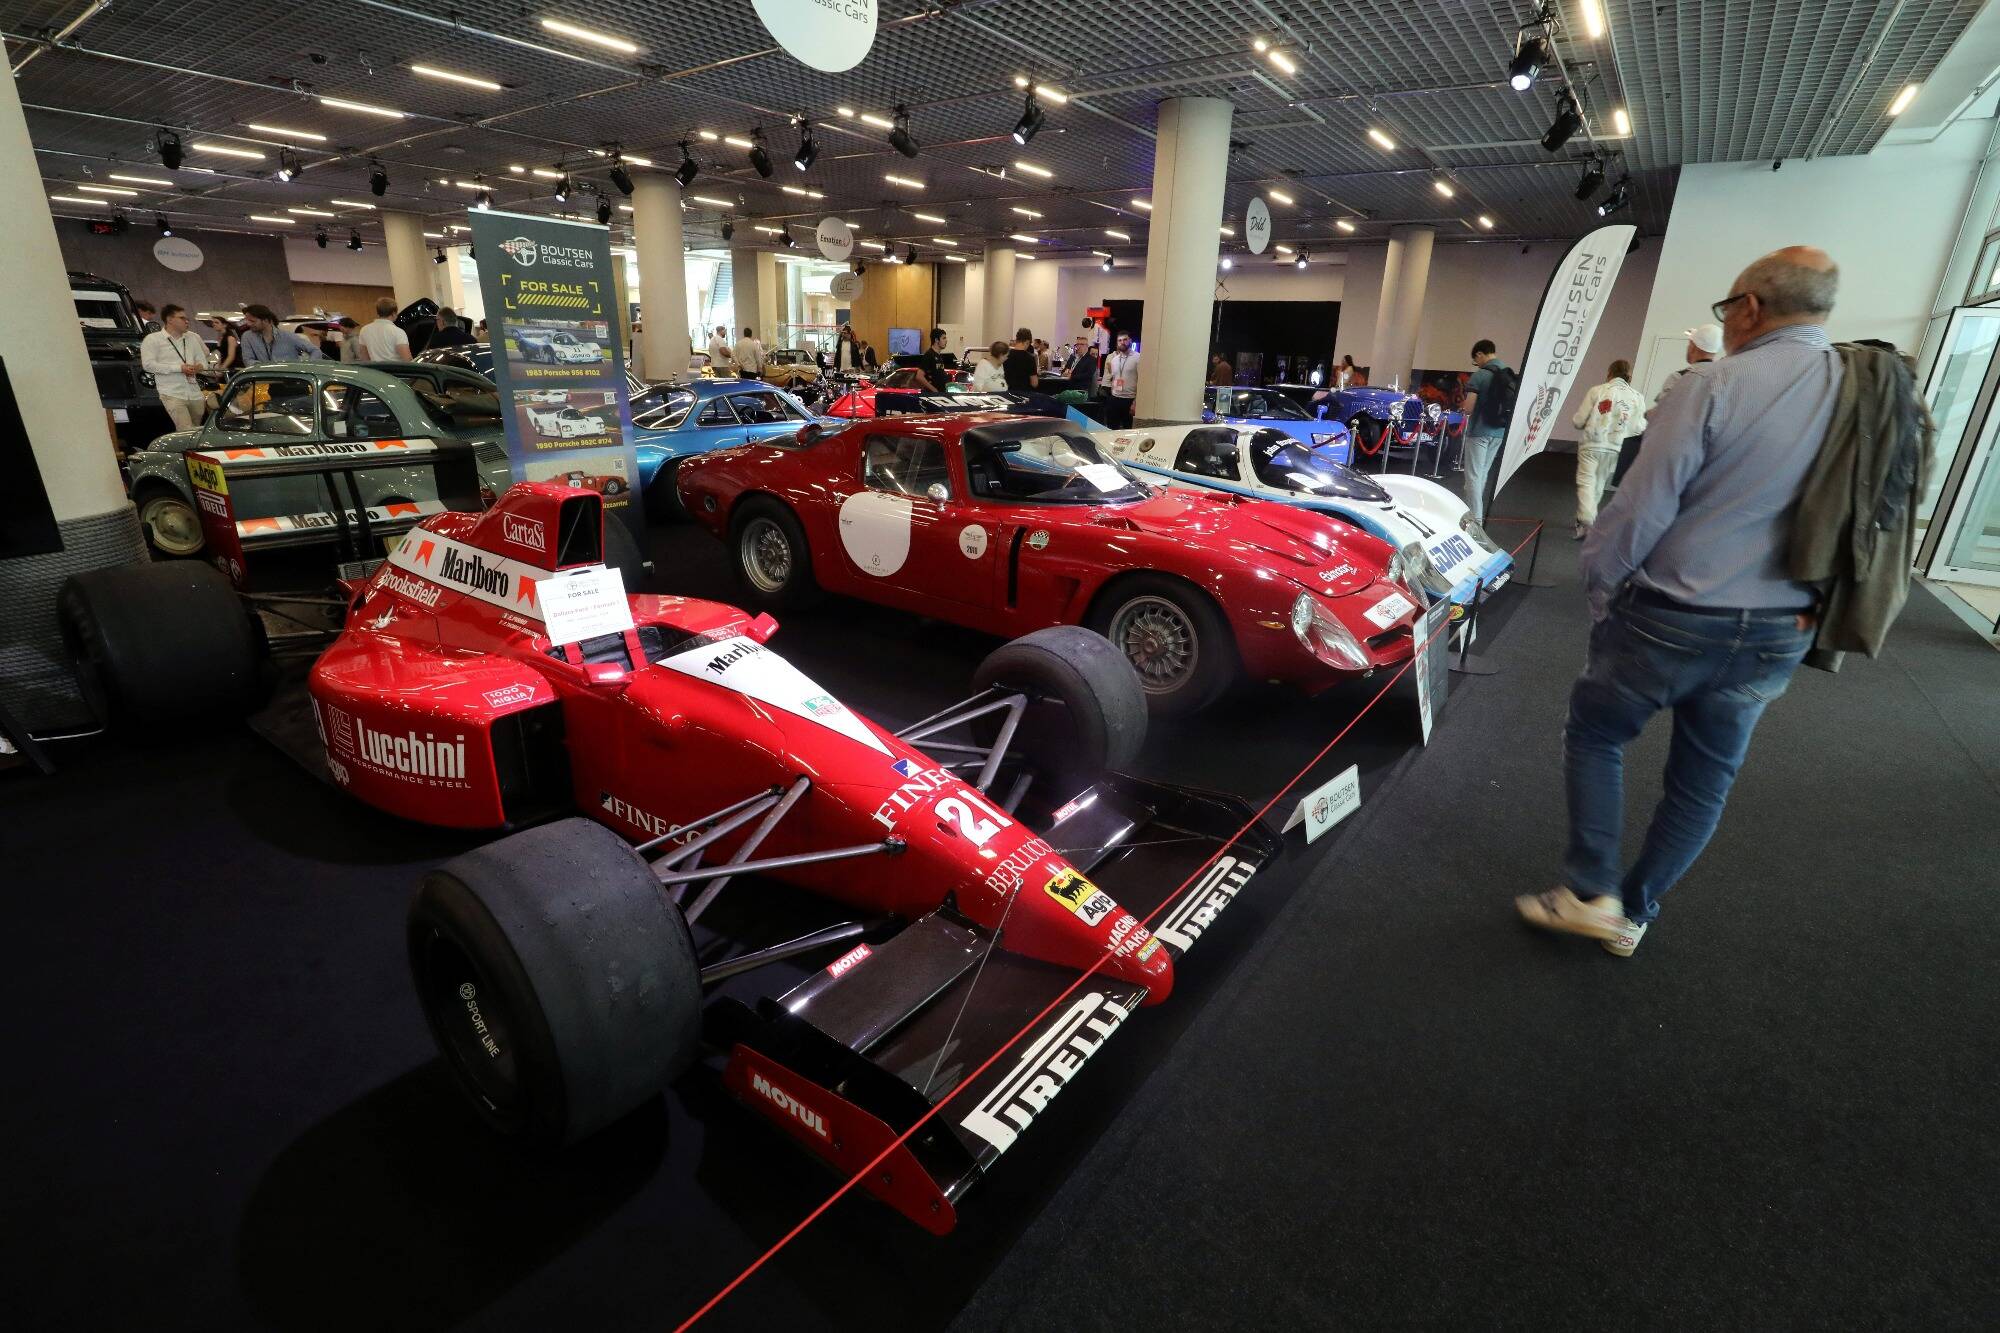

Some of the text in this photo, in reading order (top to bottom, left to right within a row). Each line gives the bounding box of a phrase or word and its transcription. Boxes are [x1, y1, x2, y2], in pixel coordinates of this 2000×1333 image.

[844, 4, 868, 23] Cars
[540, 244, 593, 260] BOUTSEN
[542, 255, 594, 269] Classic Cars
[520, 280, 584, 295] FOR SALE
[1584, 256, 1607, 302] Cars
[1547, 252, 1594, 375] BOUTSEN
[543, 369, 570, 377] Porsche
[273, 442, 368, 457] Marlboro
[553, 440, 580, 449] Porsche
[199, 462, 219, 490] Agip
[288, 510, 380, 529] Marloo
[503, 514, 546, 550] CartaSi
[439, 546, 509, 598] Marlboro
[379, 567, 442, 608] Brooksfield
[568, 588, 600, 599] FOR SALE
[489, 687, 519, 698] 1000
[356, 717, 466, 779] Lucchini
[352, 757, 424, 785] PERFORMANCE
[429, 778, 472, 789] STEEL
[870, 767, 962, 832] FINEC
[1055, 801, 1079, 820] MOTUL
[934, 787, 1014, 849] 21
[1082, 894, 1112, 920] Agip
[1153, 856, 1257, 953] PIRELLI
[831, 947, 869, 976] MOTUL
[467, 1000, 488, 1034] SPORT
[482, 1034, 500, 1058] LINE
[960, 992, 1129, 1155] PIRELLI
[752, 1074, 827, 1137] MOTUL
